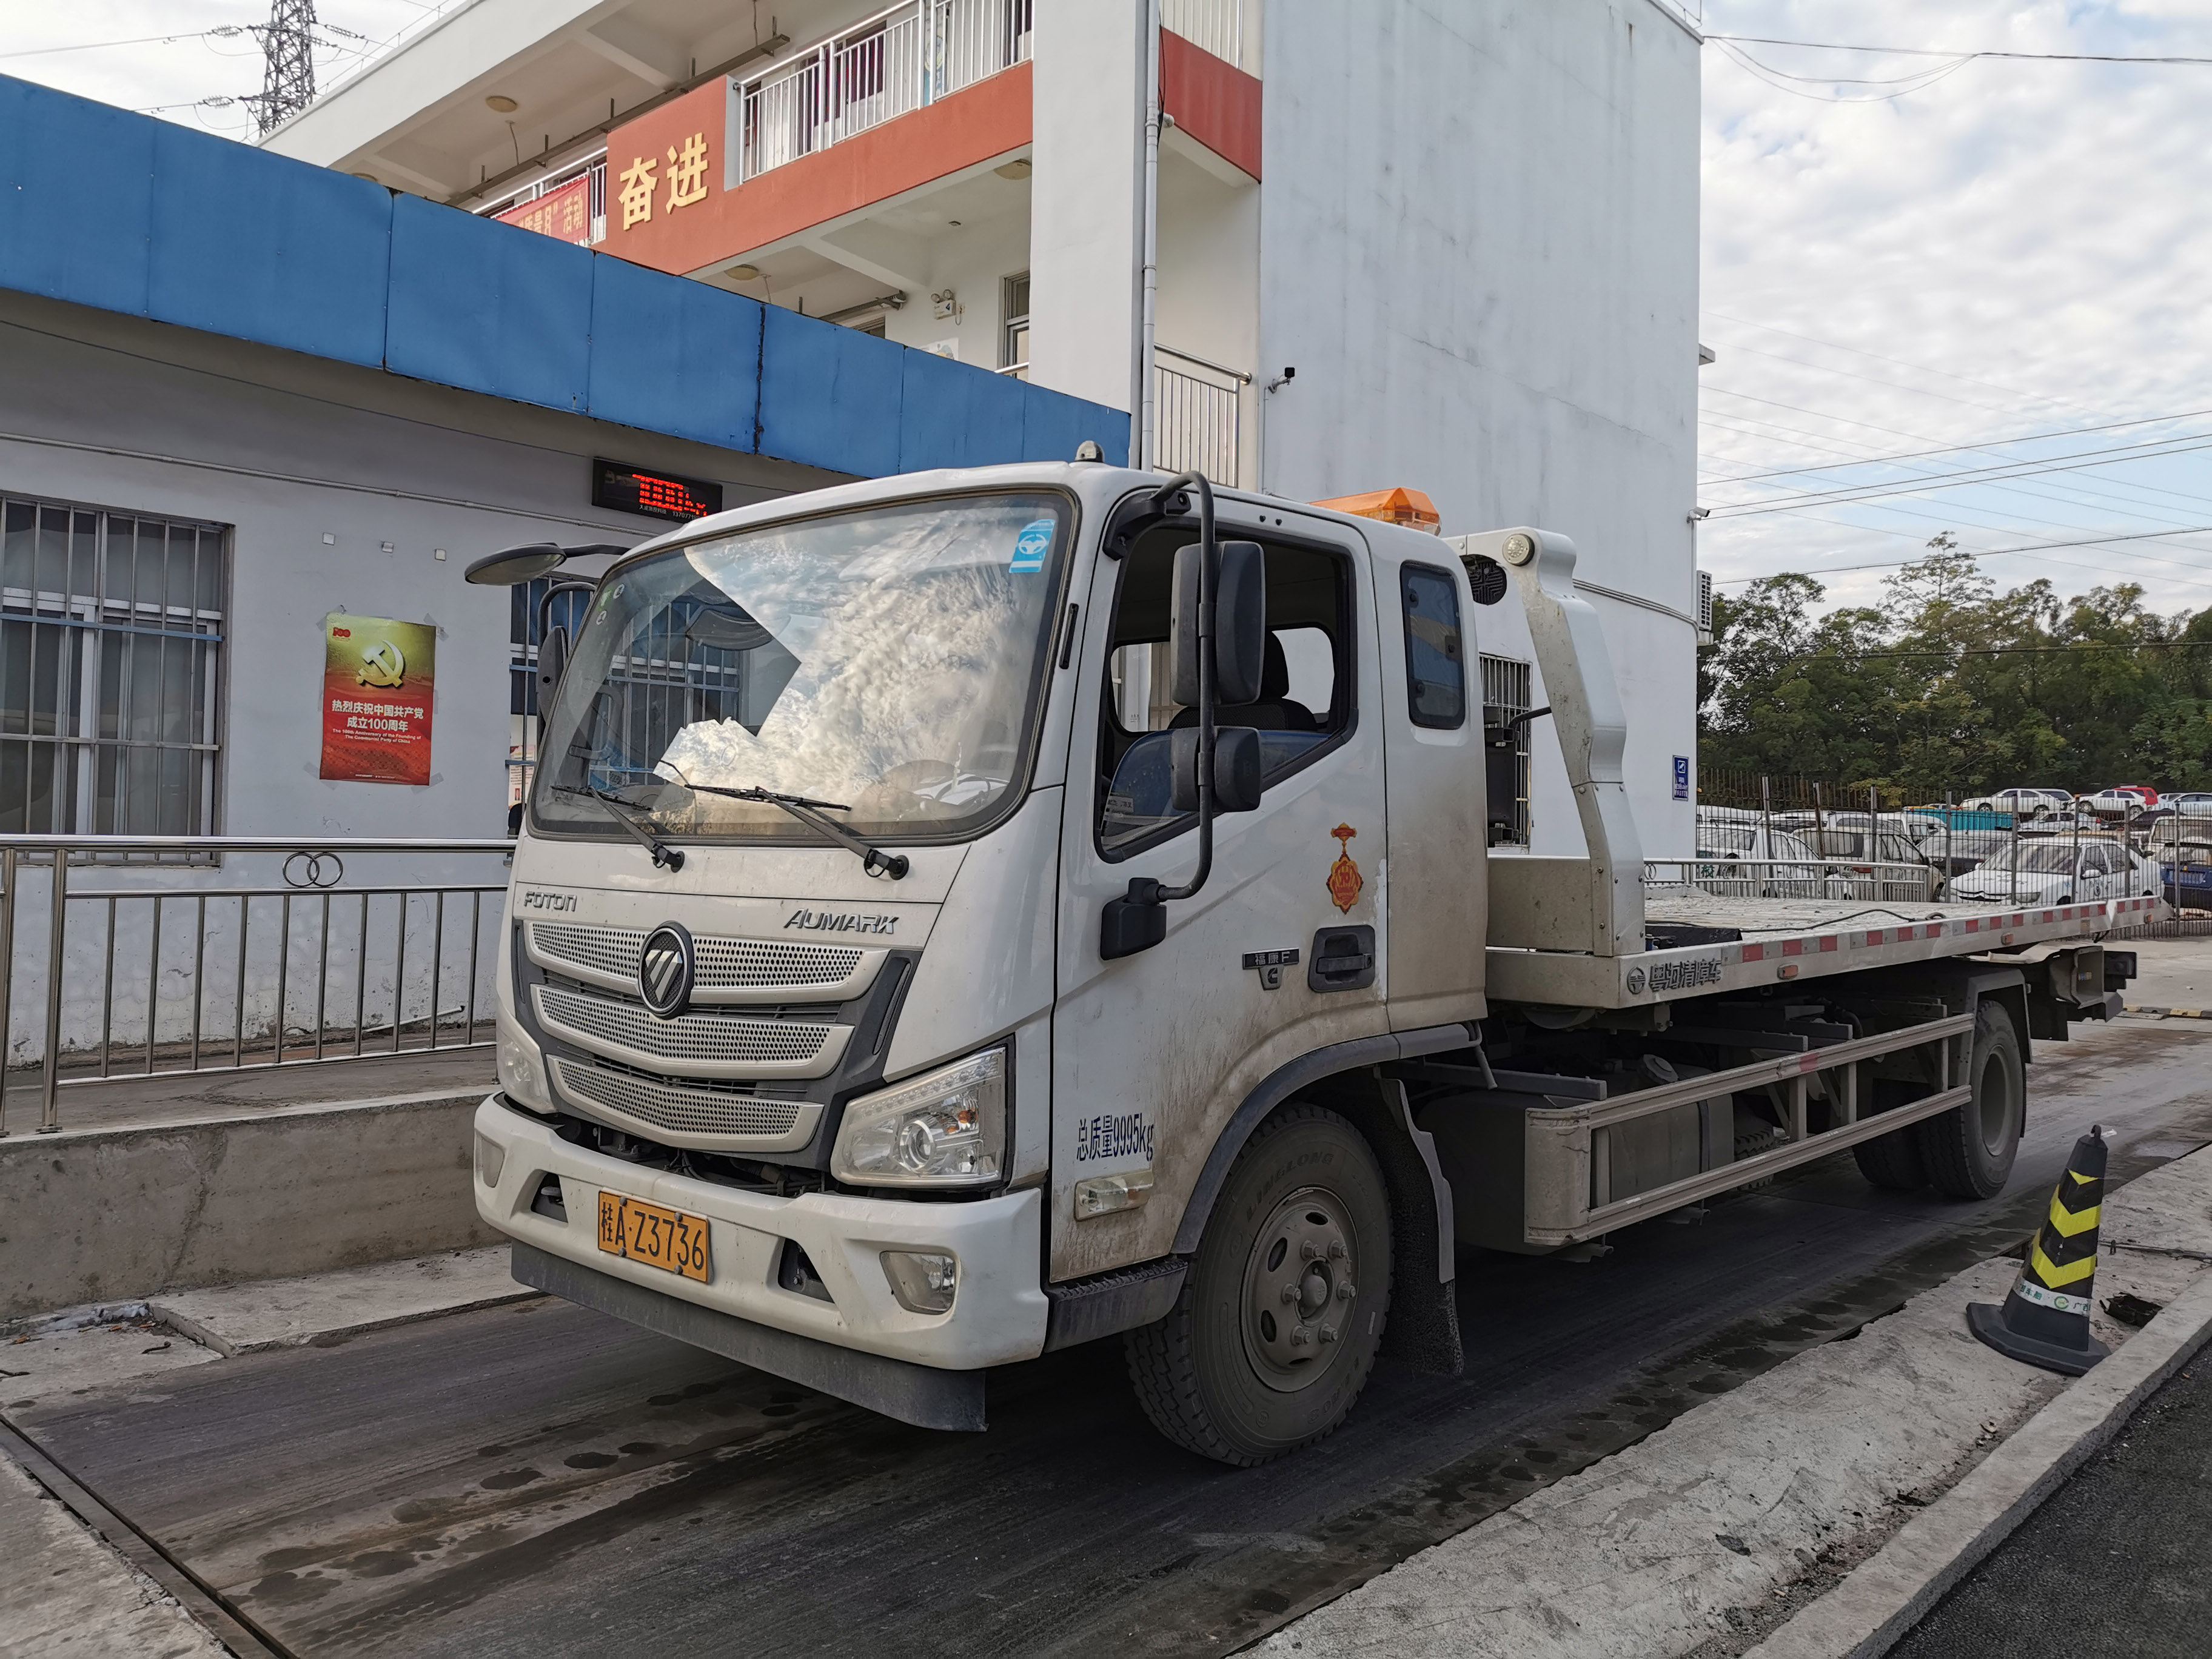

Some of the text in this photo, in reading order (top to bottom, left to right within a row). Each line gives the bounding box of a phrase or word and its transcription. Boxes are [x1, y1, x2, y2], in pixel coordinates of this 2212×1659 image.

[617, 132, 709, 231] 奋进
[332, 699, 424, 720] 热烈庆祝中国共产党
[347, 716, 409, 732] 成立100周年
[524, 890, 577, 912] FOTON
[783, 907, 899, 934] AUMARK
[1076, 1112, 1154, 1162] 总质量9995kg
